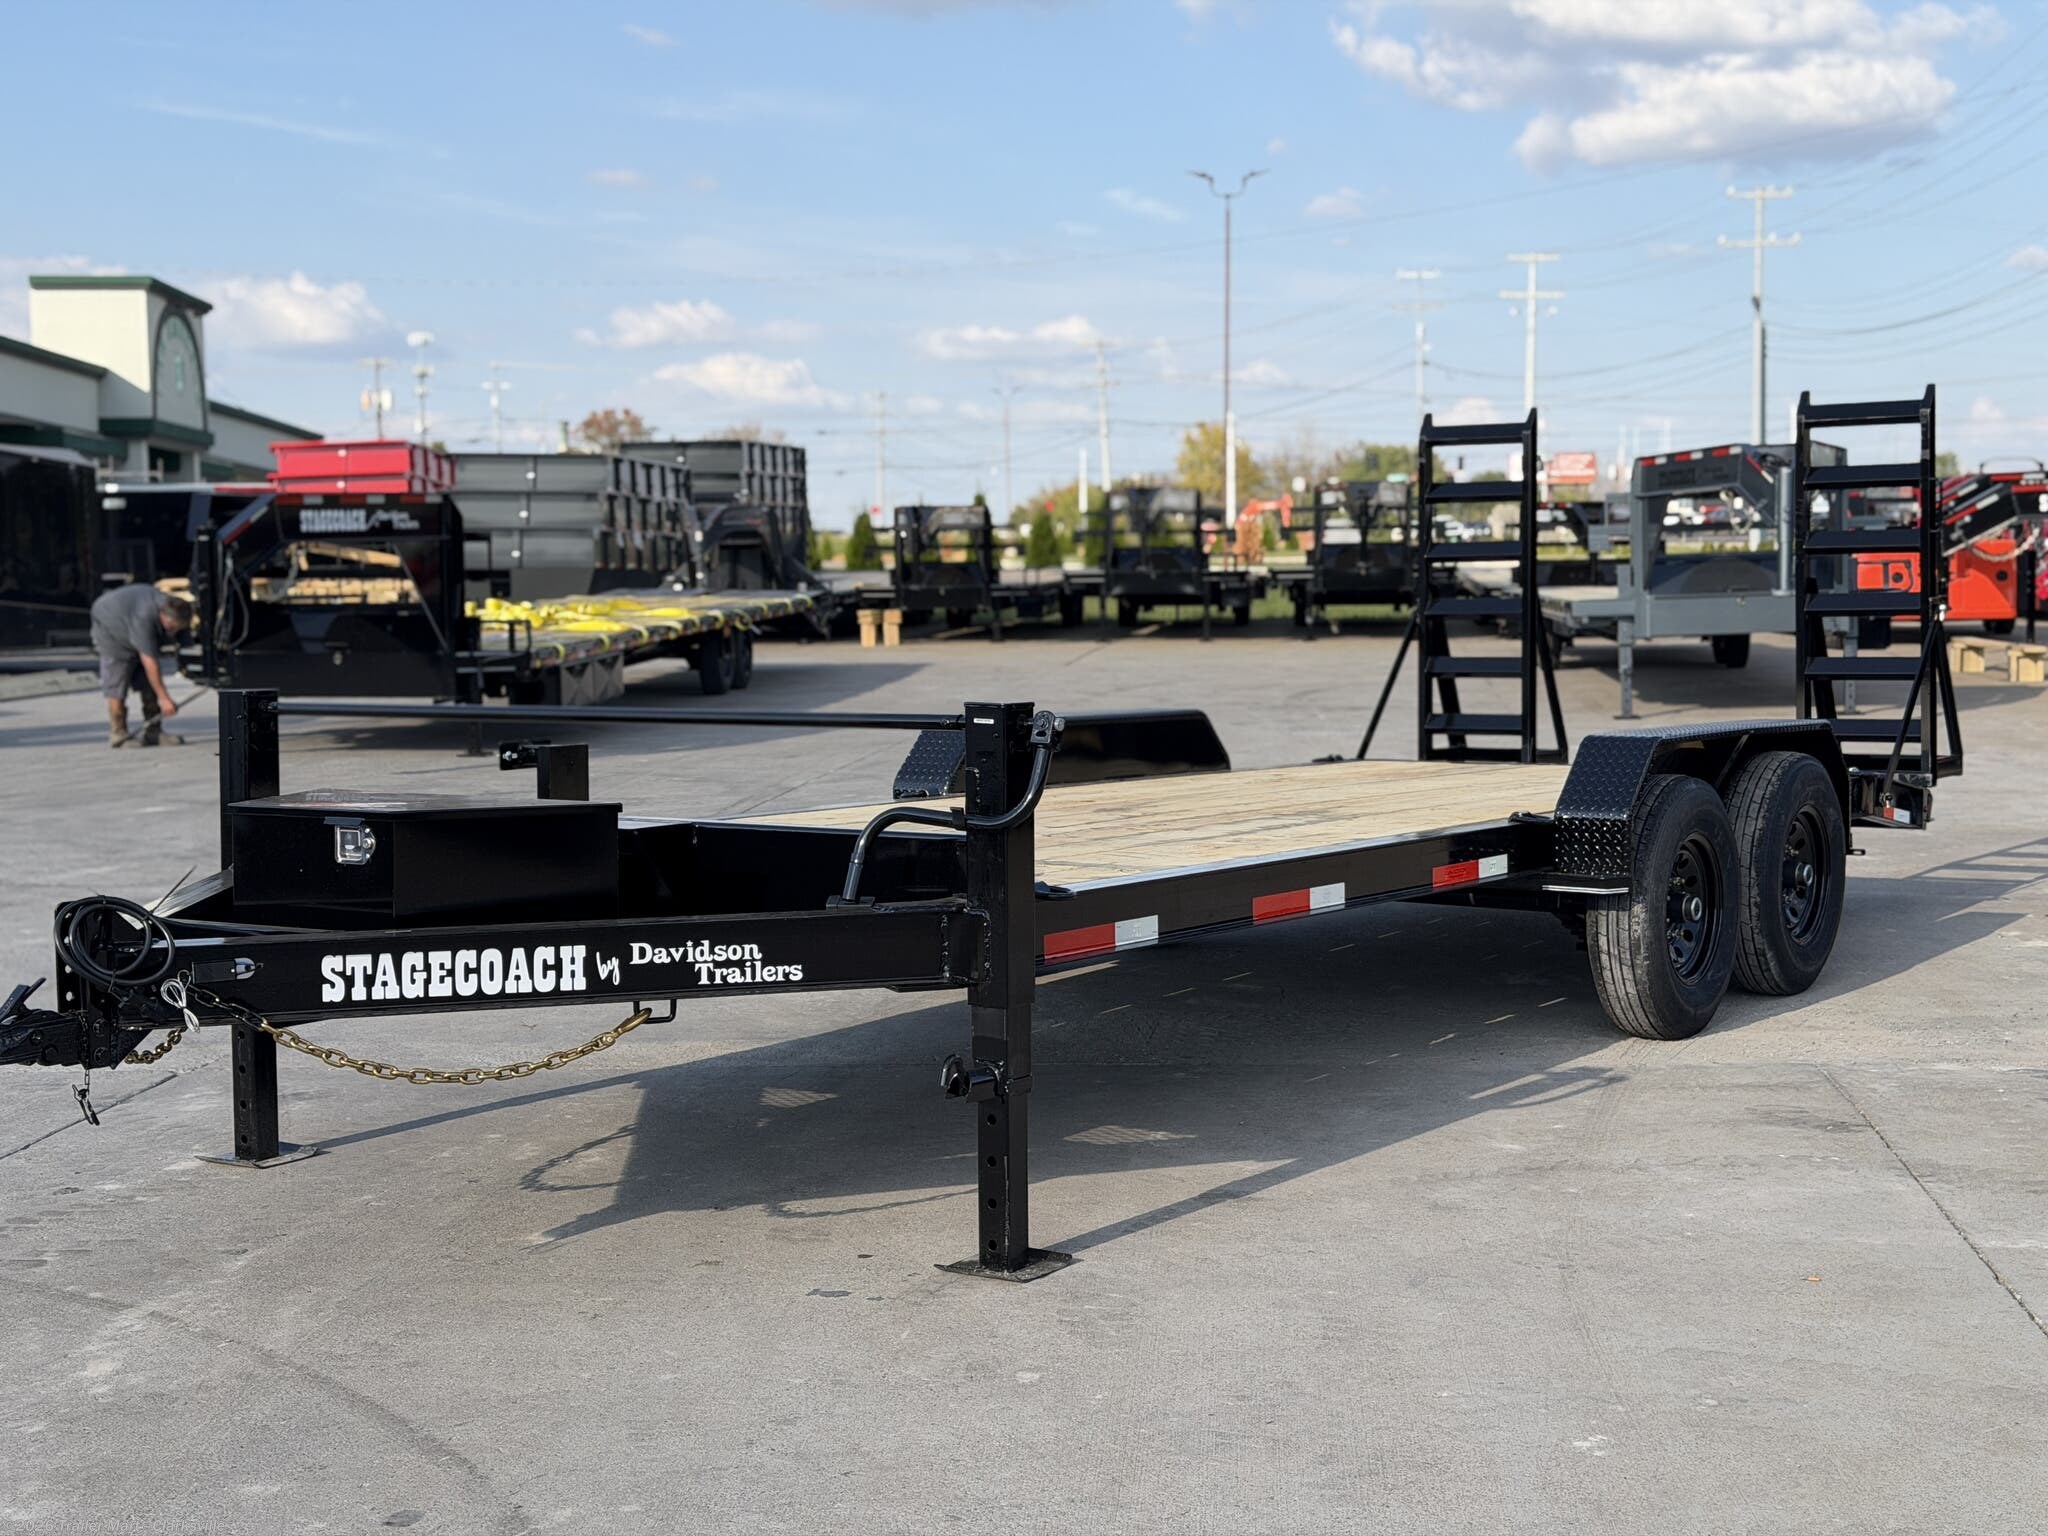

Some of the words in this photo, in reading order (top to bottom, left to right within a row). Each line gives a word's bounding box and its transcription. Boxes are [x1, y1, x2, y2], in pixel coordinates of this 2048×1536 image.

[321, 945, 587, 1003] STAGECOACH
[596, 951, 621, 986] by
[629, 939, 763, 965] Davidson
[694, 961, 804, 985] Trailers
